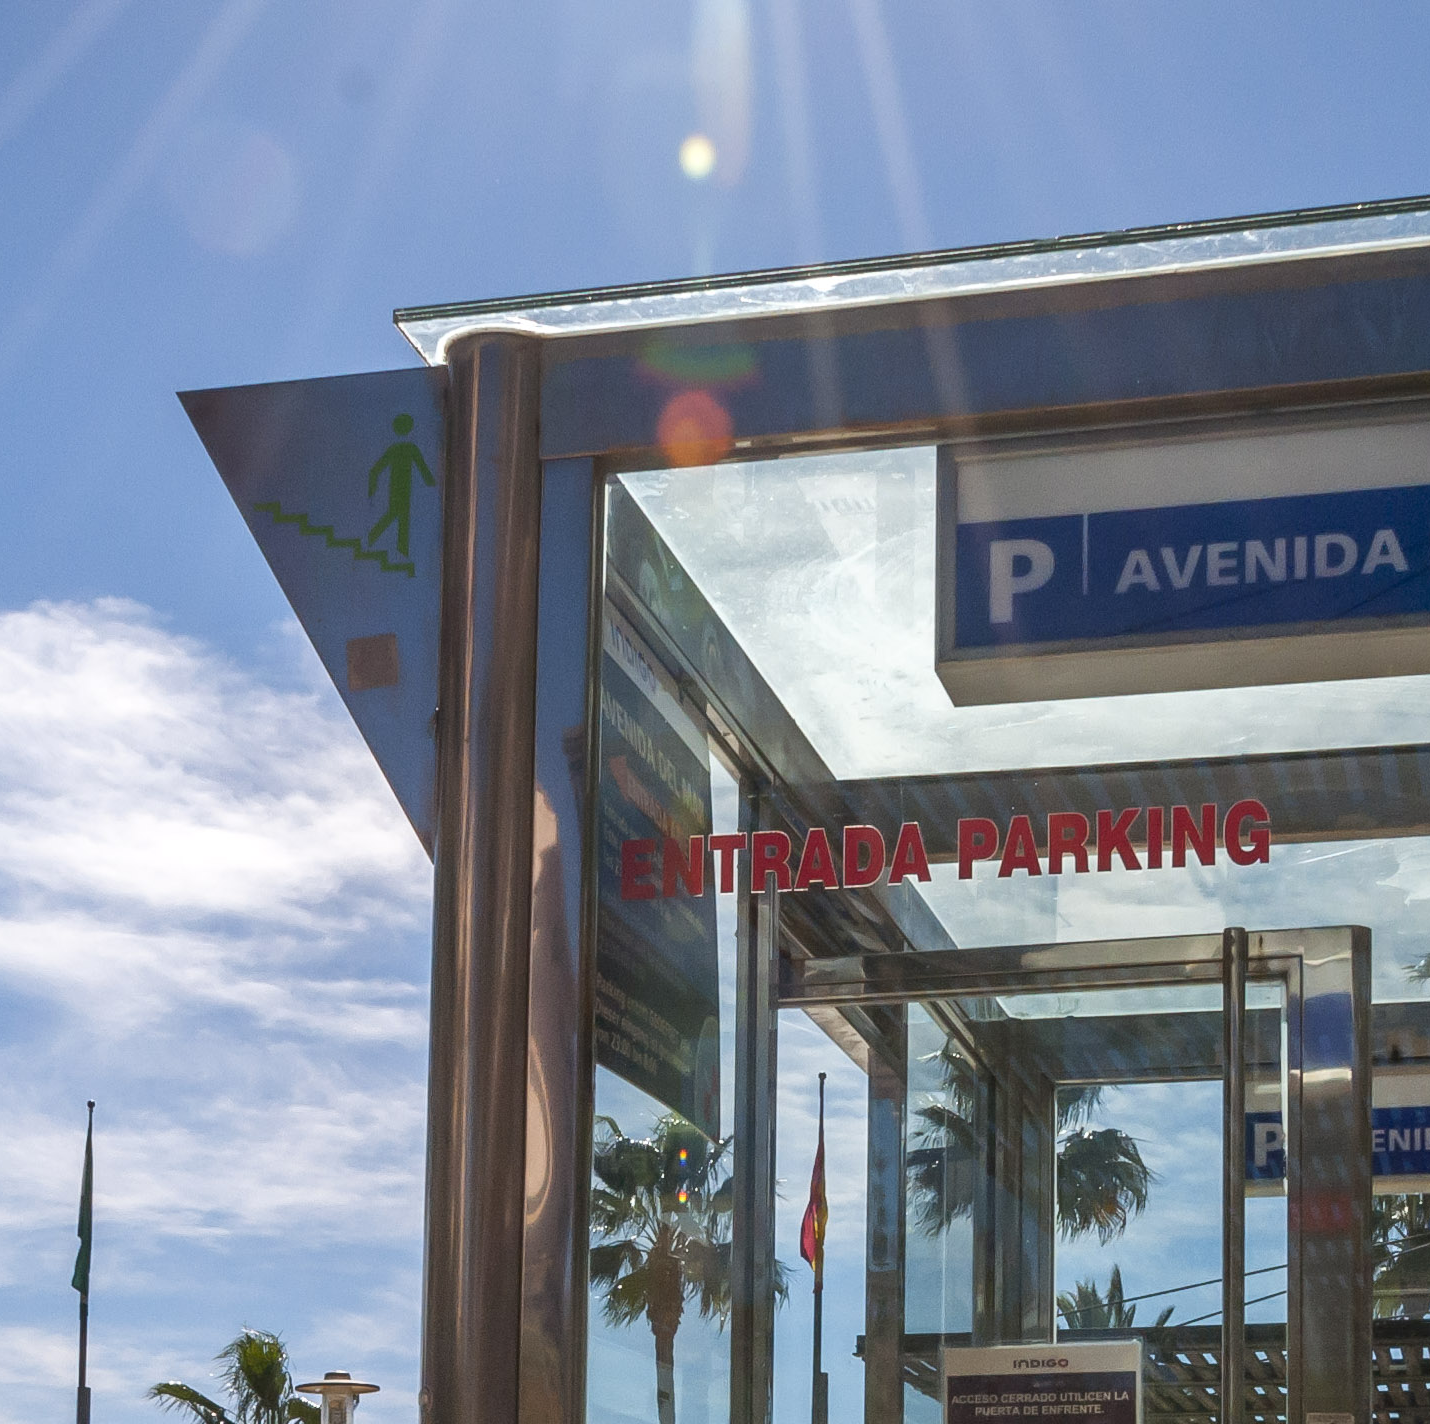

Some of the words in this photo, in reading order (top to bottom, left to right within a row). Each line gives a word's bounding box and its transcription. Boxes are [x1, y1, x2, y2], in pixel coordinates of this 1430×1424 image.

[989, 539, 1055, 624] P
[1114, 529, 1408, 594] AVENIDA
[621, 821, 932, 900] ENTRADA
[958, 799, 1270, 880] PARKING
[1254, 1123, 1285, 1167] P
[1013, 1358, 1069, 1369] INDIGO
[952, 1394, 998, 1405] ACCESO
[1001, 1392, 1057, 1403] CERRADO
[1114, 1391, 1129, 1401] LA
[975, 1406, 1020, 1416] PUERTA
[1023, 1405, 1039, 1415] DE
